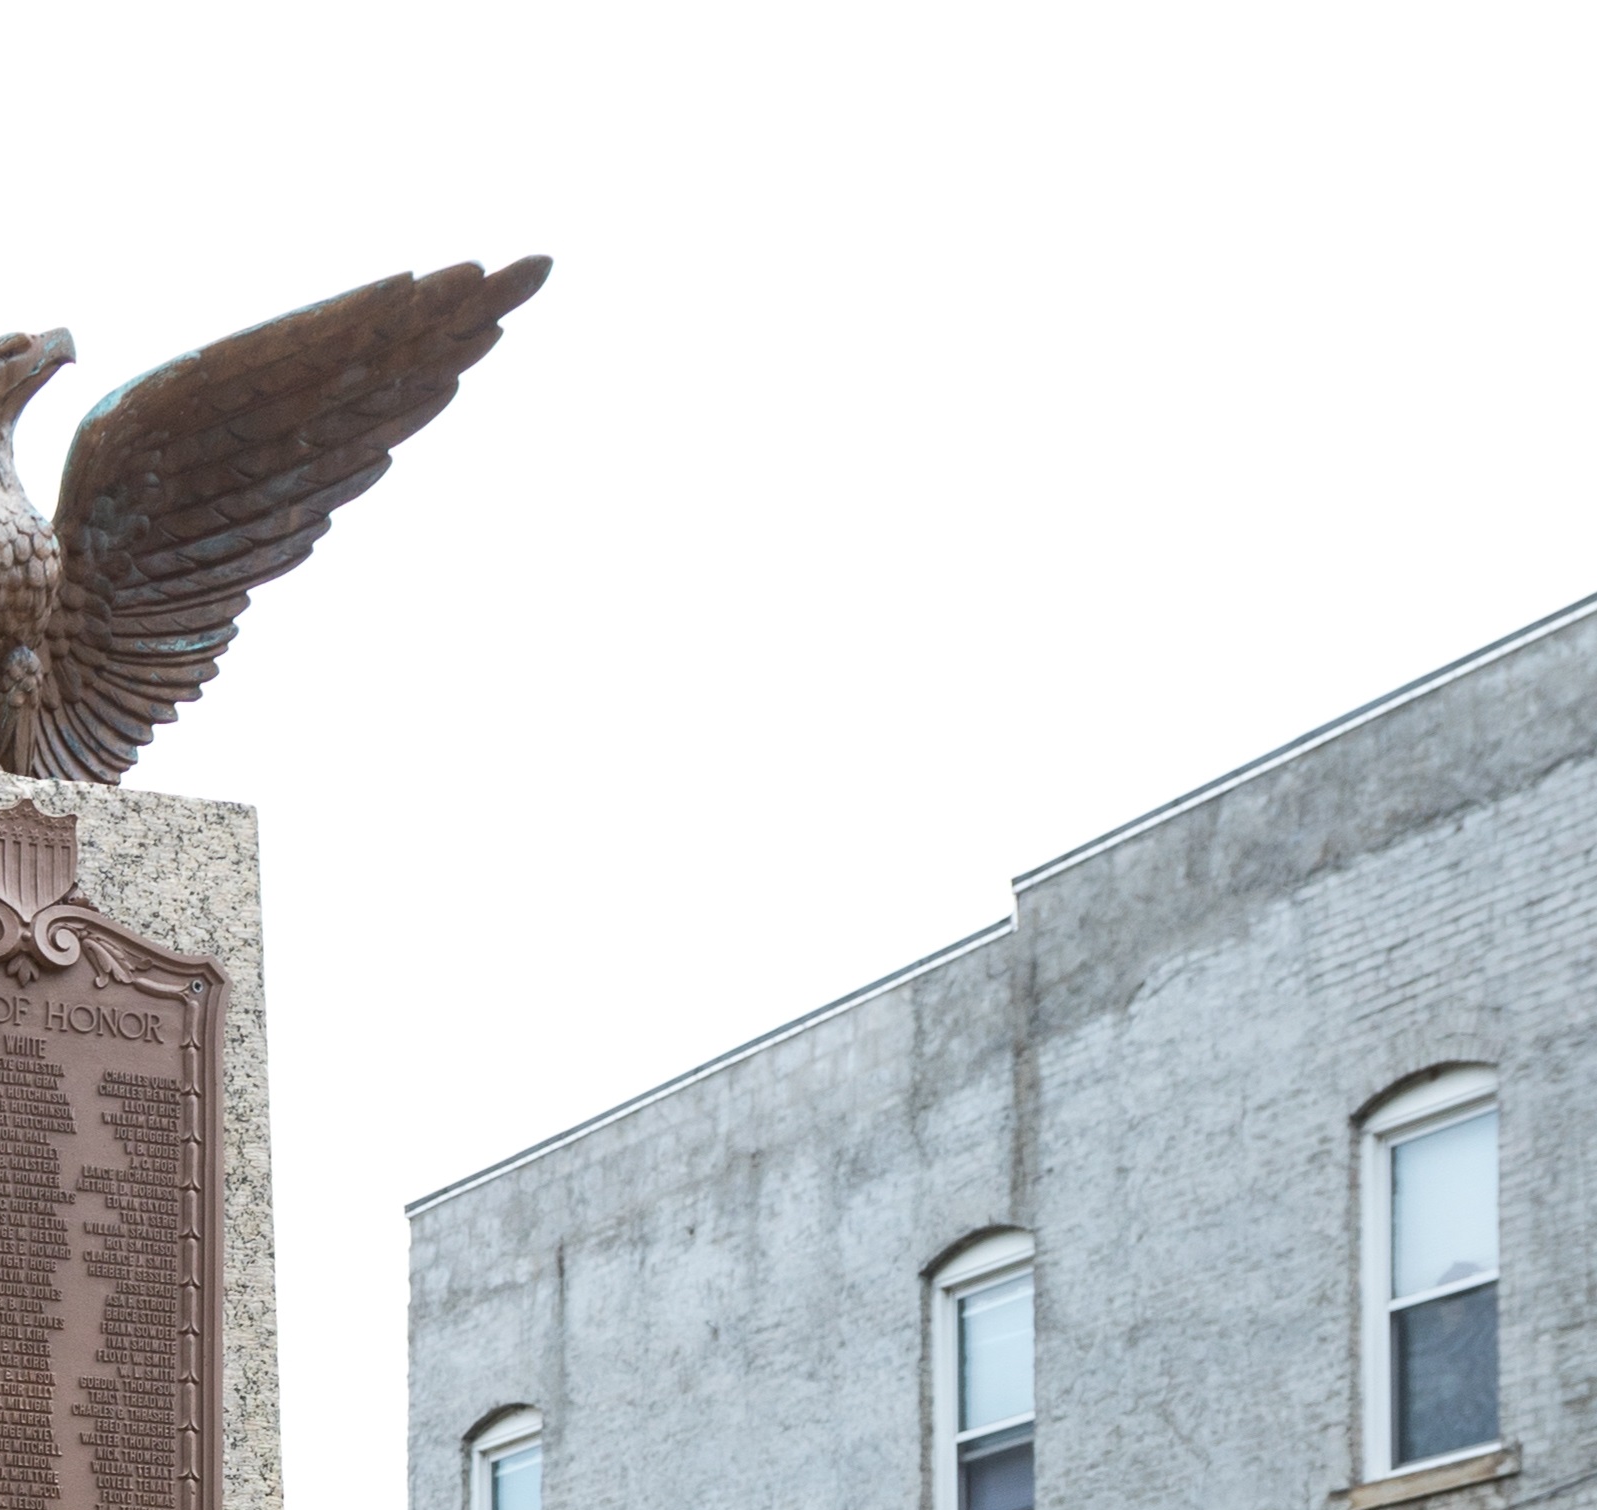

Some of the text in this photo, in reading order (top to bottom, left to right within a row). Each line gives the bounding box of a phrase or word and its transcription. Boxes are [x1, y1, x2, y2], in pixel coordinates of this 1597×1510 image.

[44, 999, 163, 1044] HONOR
[3, 1034, 47, 1059] WHITE
[34, 1074, 59, 1089] GRAY
[7, 1085, 70, 1104] HUTCHINSON
[10, 1100, 73, 1119] HUTCHINSON
[124, 1100, 180, 1118] LLOYD RICE
[13, 1114, 77, 1133] HUTCHINSON
[24, 1129, 50, 1144] HALL
[14, 1143, 58, 1159] HUNDLEY
[84, 1221, 177, 1243] WILLIAM SPANGLER
[28, 1256, 57, 1271] HOGG
[89, 1264, 176, 1285] HERBERT SESSLER
[30, 1285, 62, 1300] JONES
[115, 1280, 176, 1298] JESSE SPADE
[104, 1307, 176, 1326] BRUCE STOVER
[24, 1327, 49, 1342] KIRK
[130, 1338, 175, 1354] SHUMATE
[22, 1355, 51, 1370] KIRBY
[88, 1390, 174, 1410] TRACY TREADWAY
[97, 1419, 175, 1438] FRED THRASHER
[11, 1439, 62, 1456] MITCHELL
[78, 1431, 175, 1452] WALTER THOMPSON
[103, 1490, 174, 1508] FLOYD THOMAS
